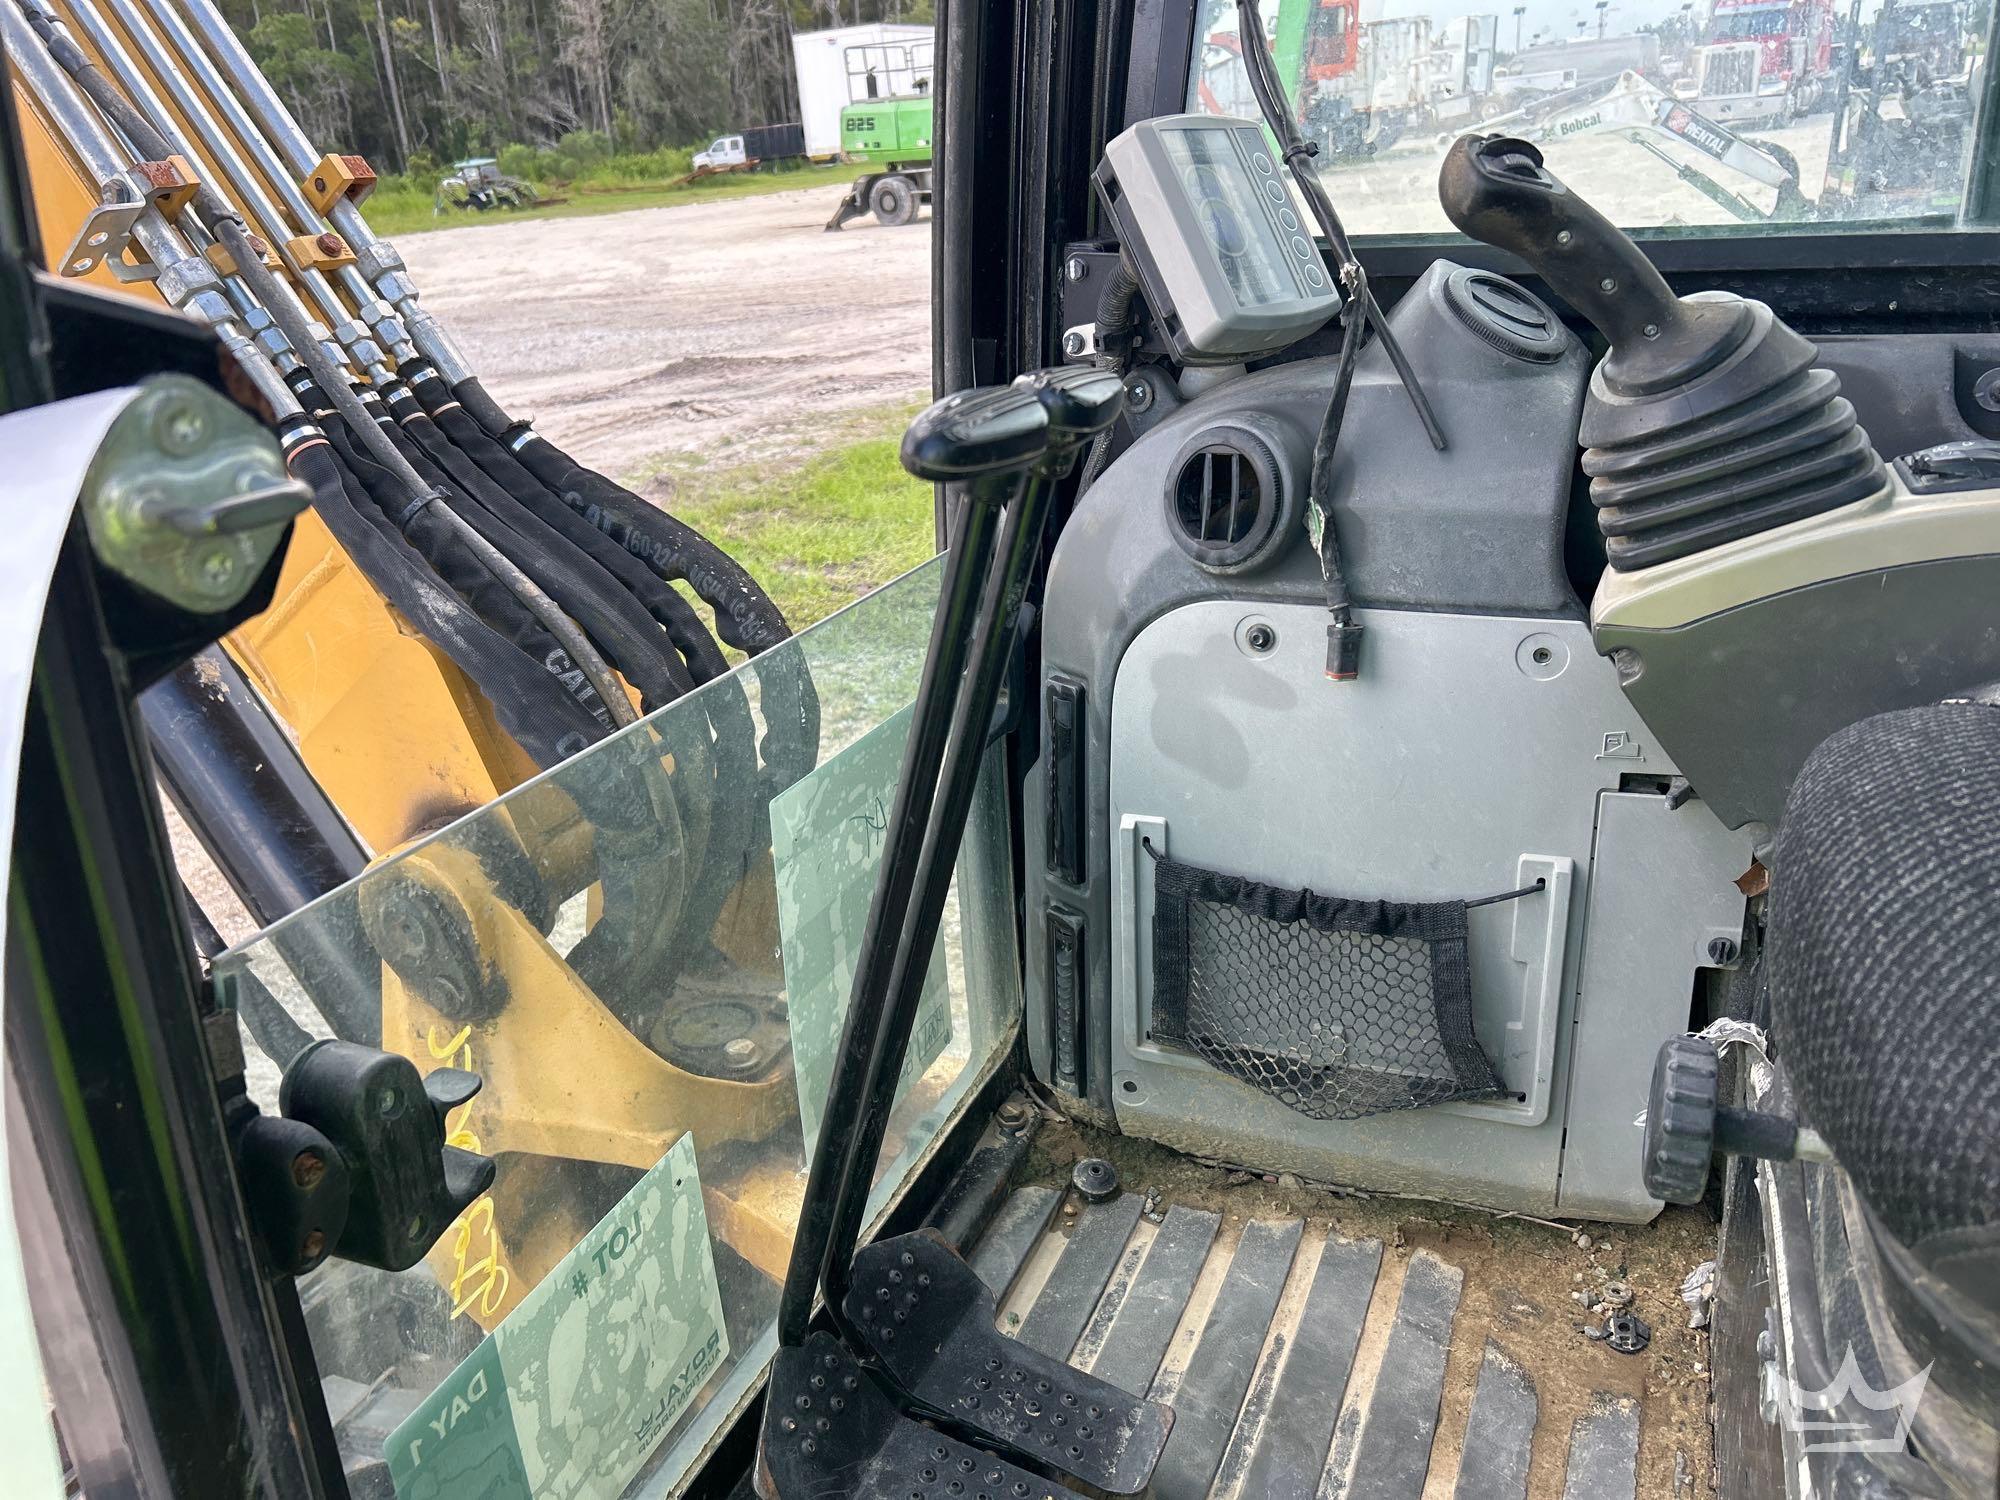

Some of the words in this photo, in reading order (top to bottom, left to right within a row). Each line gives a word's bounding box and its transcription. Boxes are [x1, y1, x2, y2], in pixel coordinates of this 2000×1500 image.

[846, 117, 875, 131] 825
[1560, 112, 1602, 136] Bobcat
[1683, 121, 1727, 154] RENTAL
